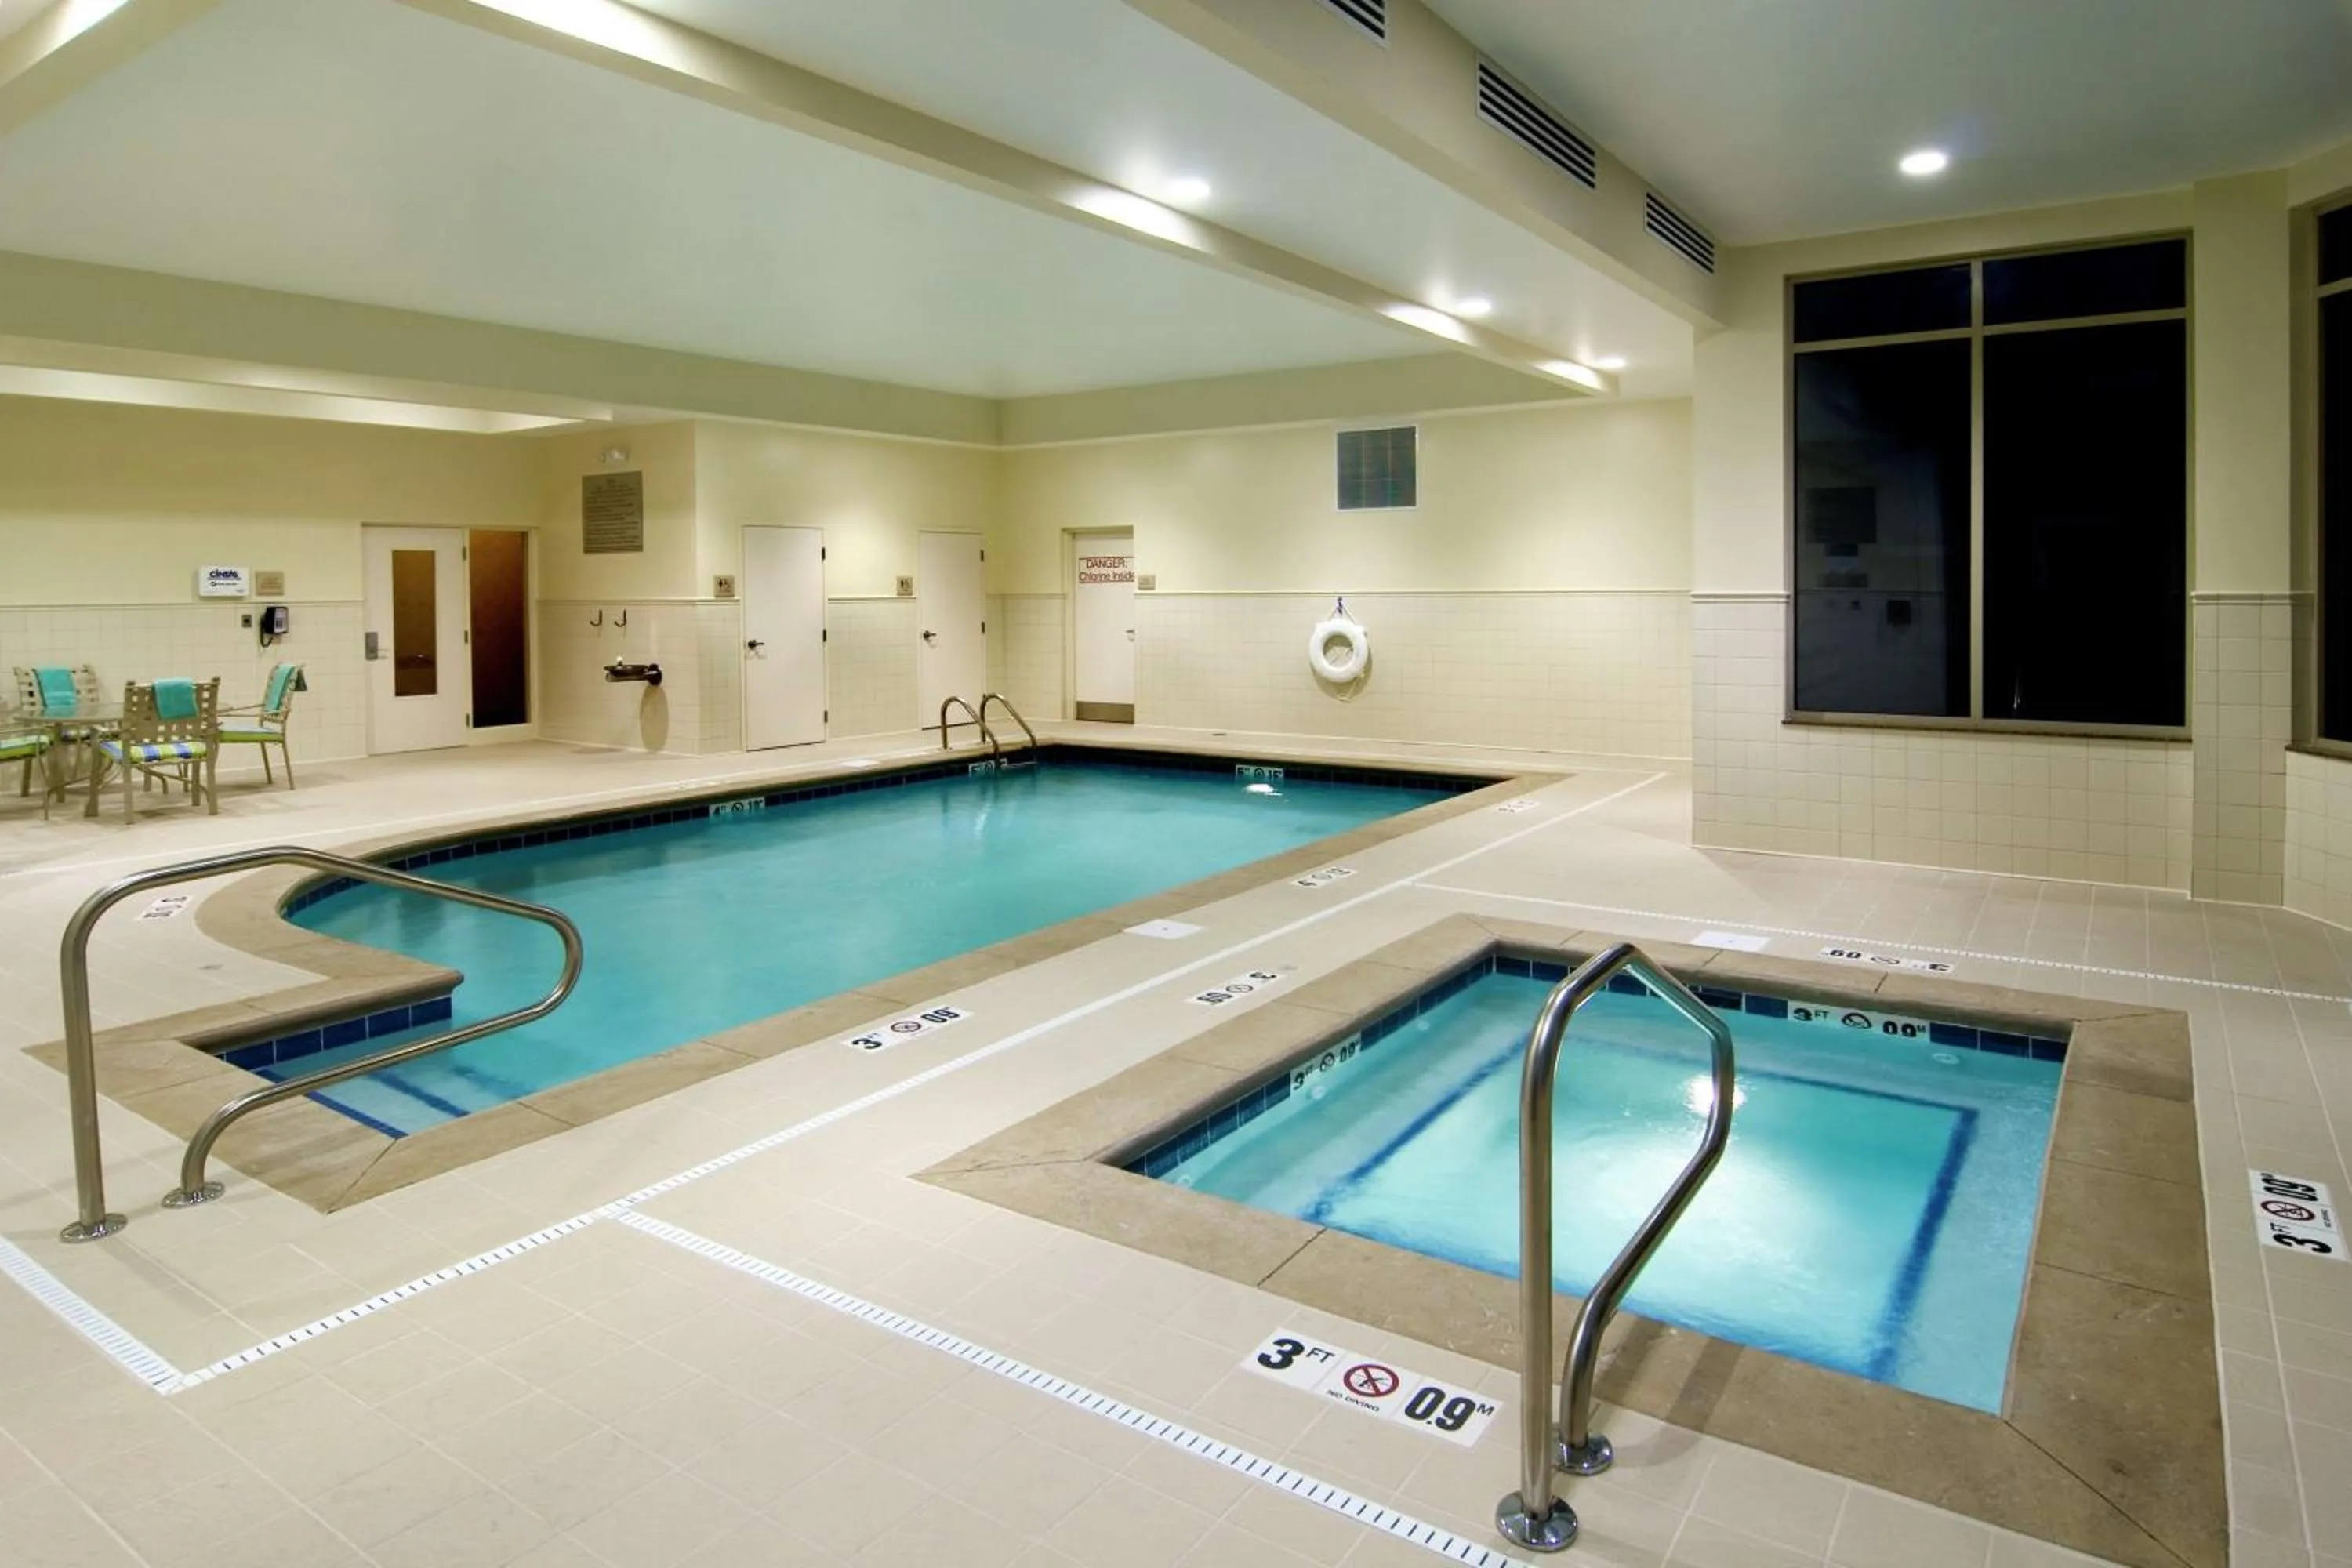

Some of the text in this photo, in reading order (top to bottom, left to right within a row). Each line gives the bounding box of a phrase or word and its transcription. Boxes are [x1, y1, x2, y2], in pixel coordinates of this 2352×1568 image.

[1086, 557, 1126, 568] DANGER
[851, 1037, 883, 1049] 3
[2273, 1233, 2332, 1254] 3
[1257, 1338, 1305, 1370] 3
[1306, 1347, 1336, 1364] FT
